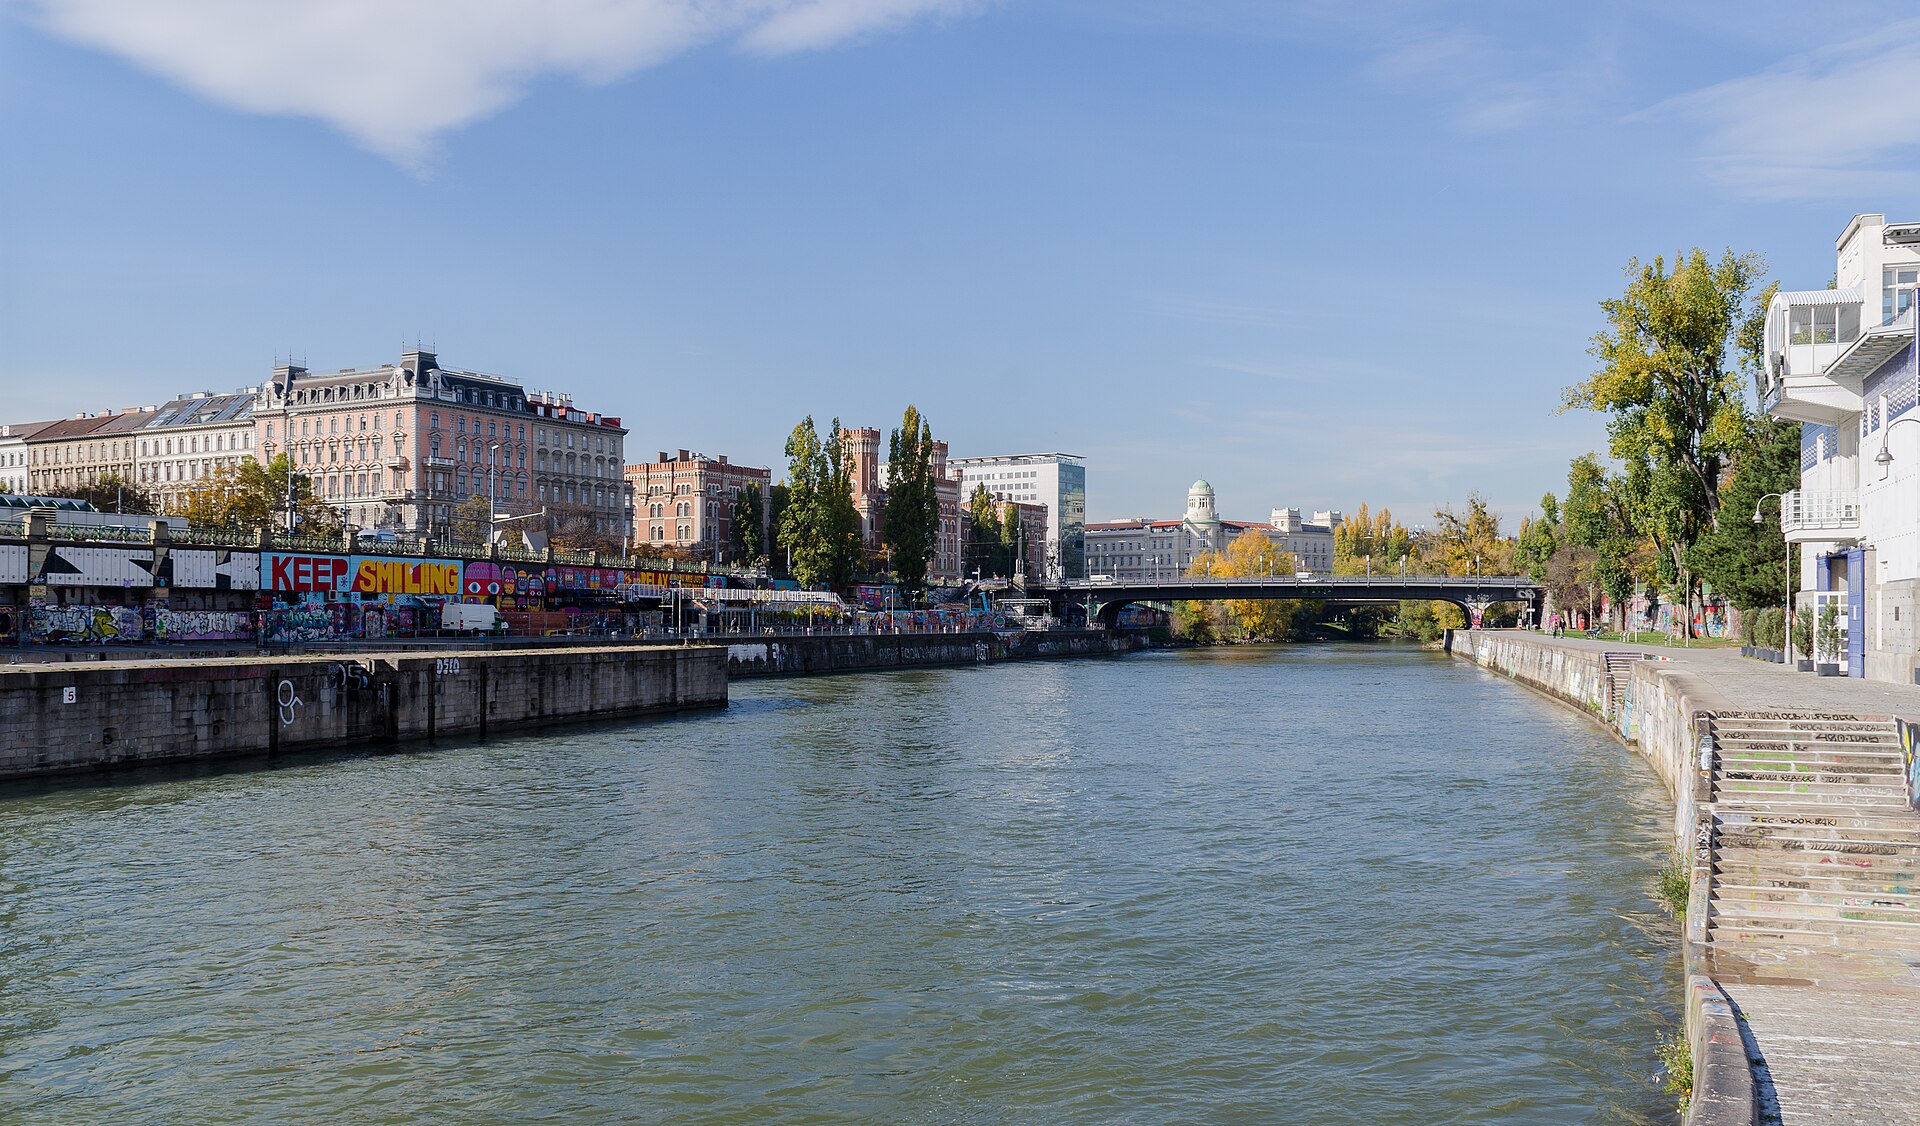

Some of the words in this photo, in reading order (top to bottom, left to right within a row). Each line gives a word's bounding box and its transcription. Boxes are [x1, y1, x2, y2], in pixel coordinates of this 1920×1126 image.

[272, 556, 348, 591] KEEP
[359, 560, 459, 594] SMILING
[641, 572, 669, 589] RELAX
[68, 691, 75, 701] 5
